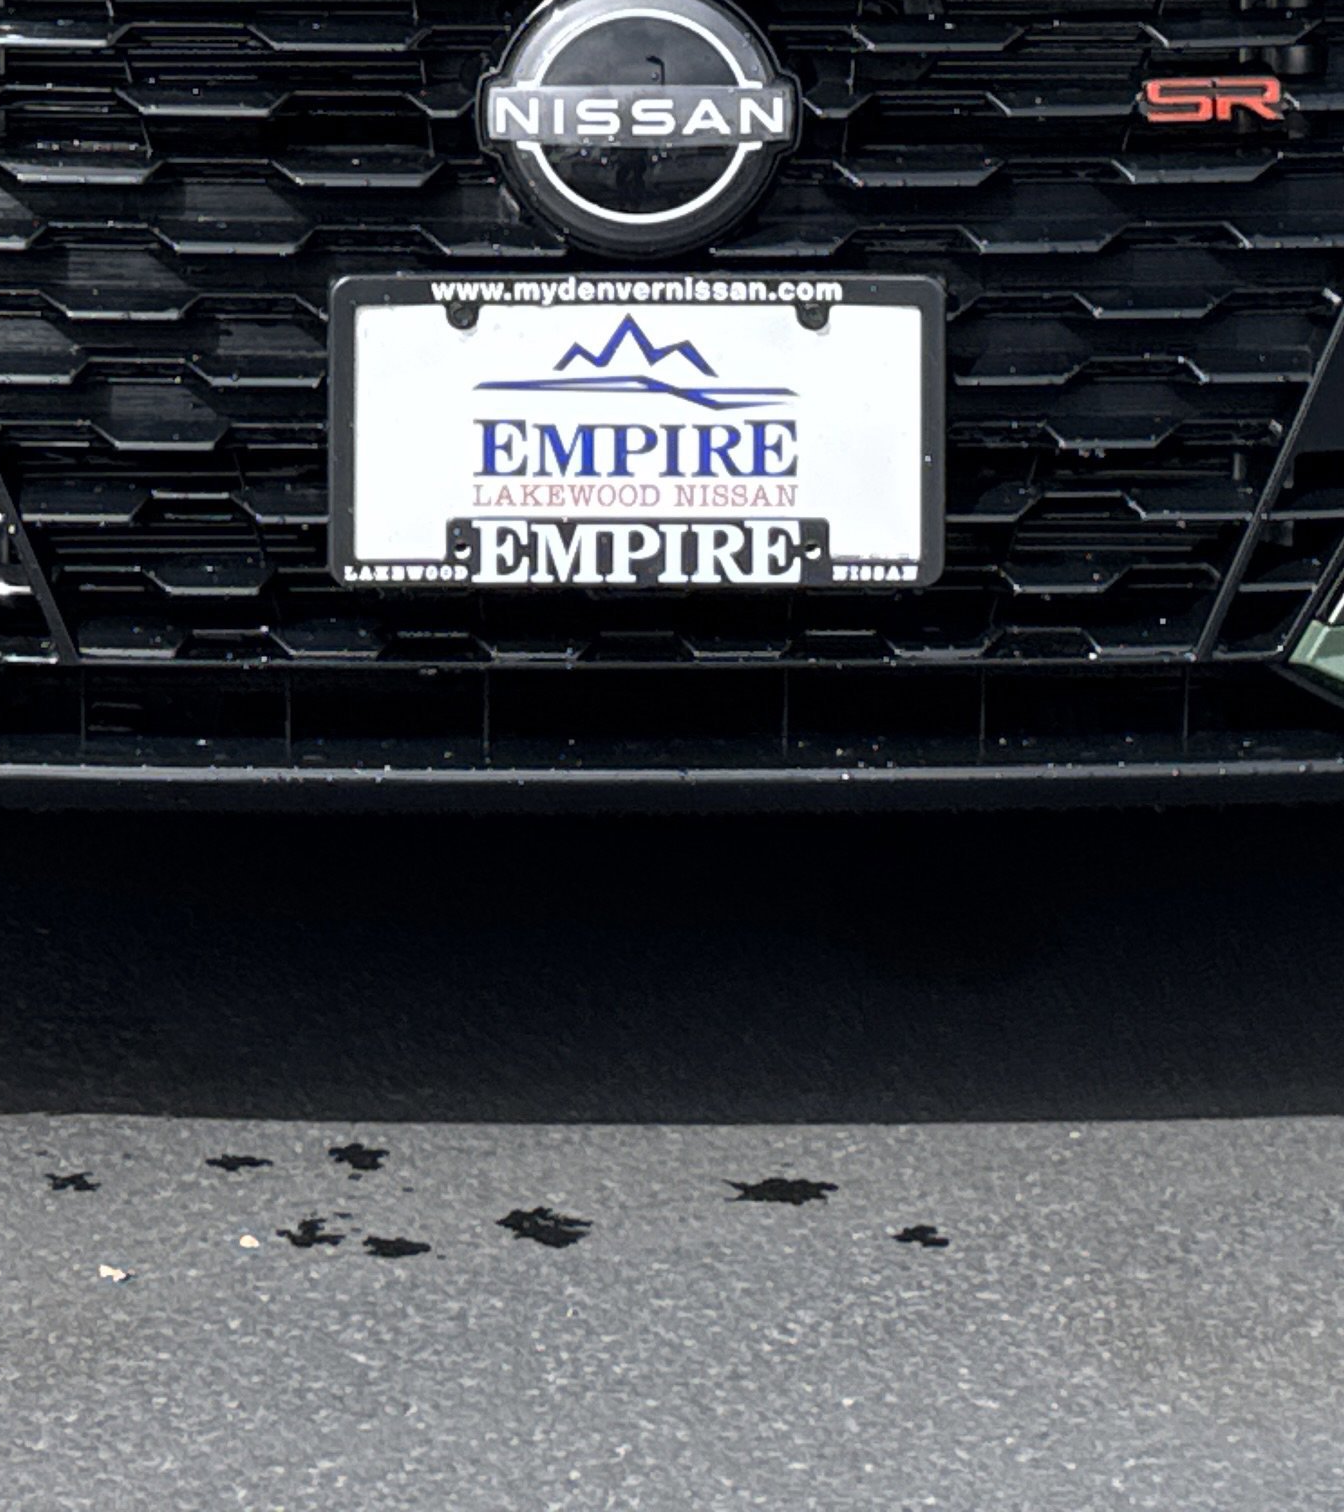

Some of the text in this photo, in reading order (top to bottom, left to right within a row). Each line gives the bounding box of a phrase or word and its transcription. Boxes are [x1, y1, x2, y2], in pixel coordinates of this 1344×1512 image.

[494, 96, 785, 136] NISSAN
[1146, 78, 1285, 123] SR
[430, 277, 844, 305] www.mydenvernissan.com
[472, 418, 799, 478] EMPIRE
[472, 484, 799, 508] LAKEWOOD NISSAN
[471, 519, 802, 585] EMPIRE
[344, 564, 468, 582] LAKEWOOD
[832, 564, 919, 582] NISSAN
